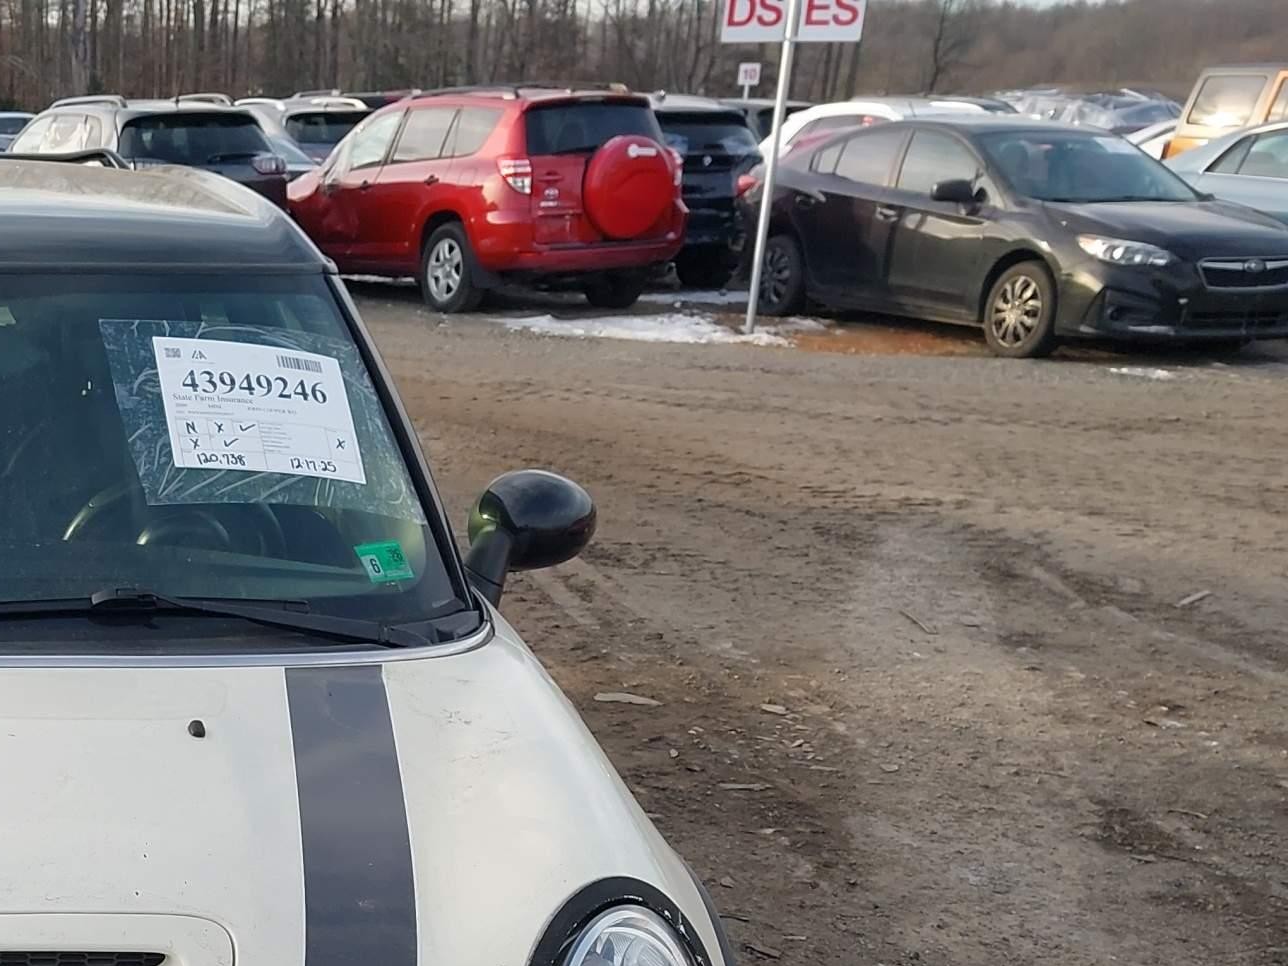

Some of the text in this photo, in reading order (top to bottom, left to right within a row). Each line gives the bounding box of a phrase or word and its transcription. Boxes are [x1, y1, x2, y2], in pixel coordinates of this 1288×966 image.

[727, 0, 783, 27] DS
[804, 0, 859, 26] ES
[182, 369, 328, 405] 43949246
[185, 421, 198, 435] N
